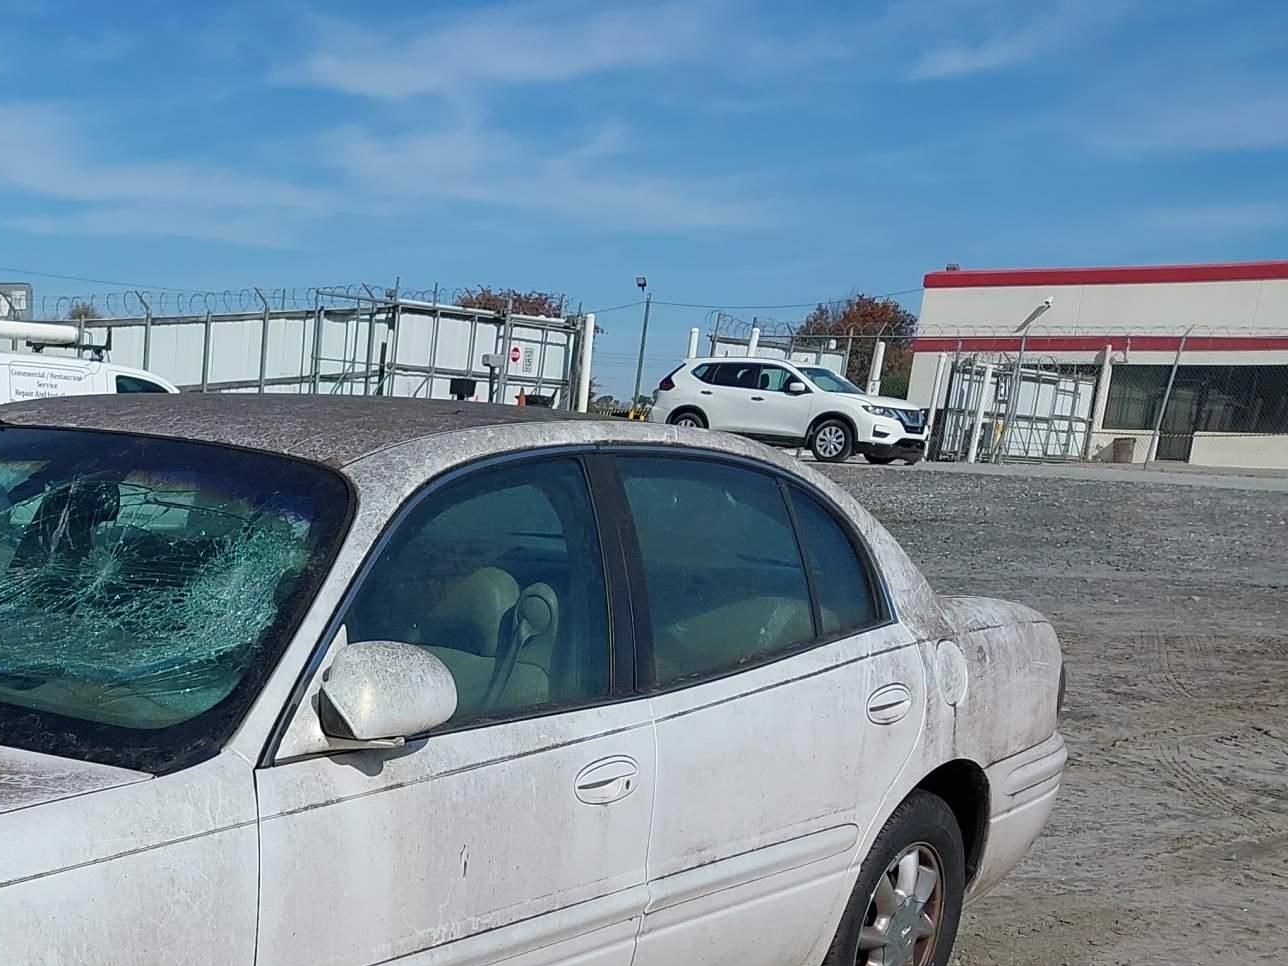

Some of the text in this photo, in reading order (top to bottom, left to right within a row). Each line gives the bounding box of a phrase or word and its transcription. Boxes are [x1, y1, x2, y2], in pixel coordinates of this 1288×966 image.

[10, 368, 46, 379] Commercial
[36, 381, 58, 389] Service
[15, 388, 34, 398] Repair
